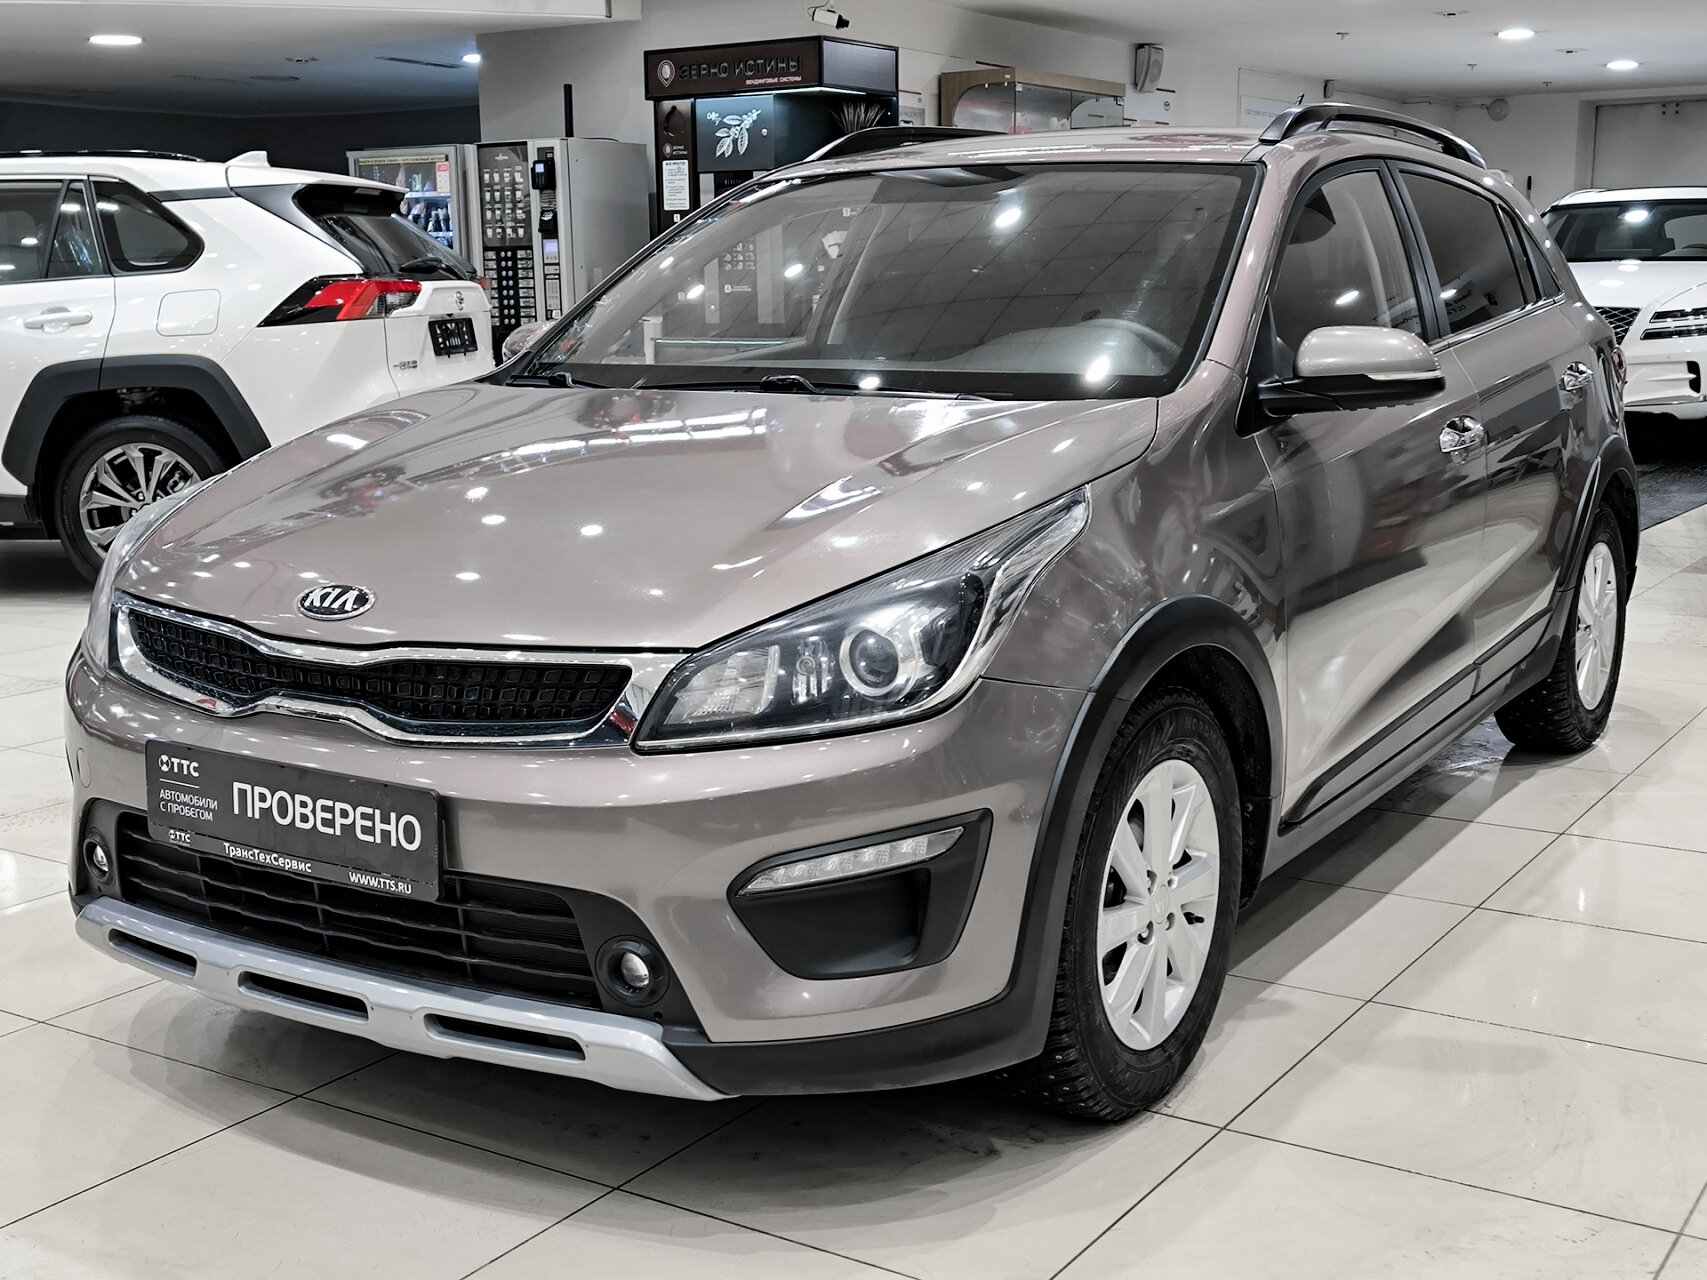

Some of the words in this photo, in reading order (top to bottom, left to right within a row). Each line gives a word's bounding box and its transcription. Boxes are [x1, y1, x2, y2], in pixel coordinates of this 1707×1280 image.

[678, 62, 729, 80] ЗЕРНО
[733, 55, 801, 76] ИСТИНЫ
[303, 587, 359, 612] KIA
[171, 757, 199, 777] ТТС
[159, 789, 218, 810] АВТОМОБИЛИ
[160, 801, 166, 811] С
[168, 803, 213, 821] ПРОБЕГОМ
[232, 781, 422, 851] ПРОВЕРЕНО
[223, 842, 312, 873] ТрансТехСервис
